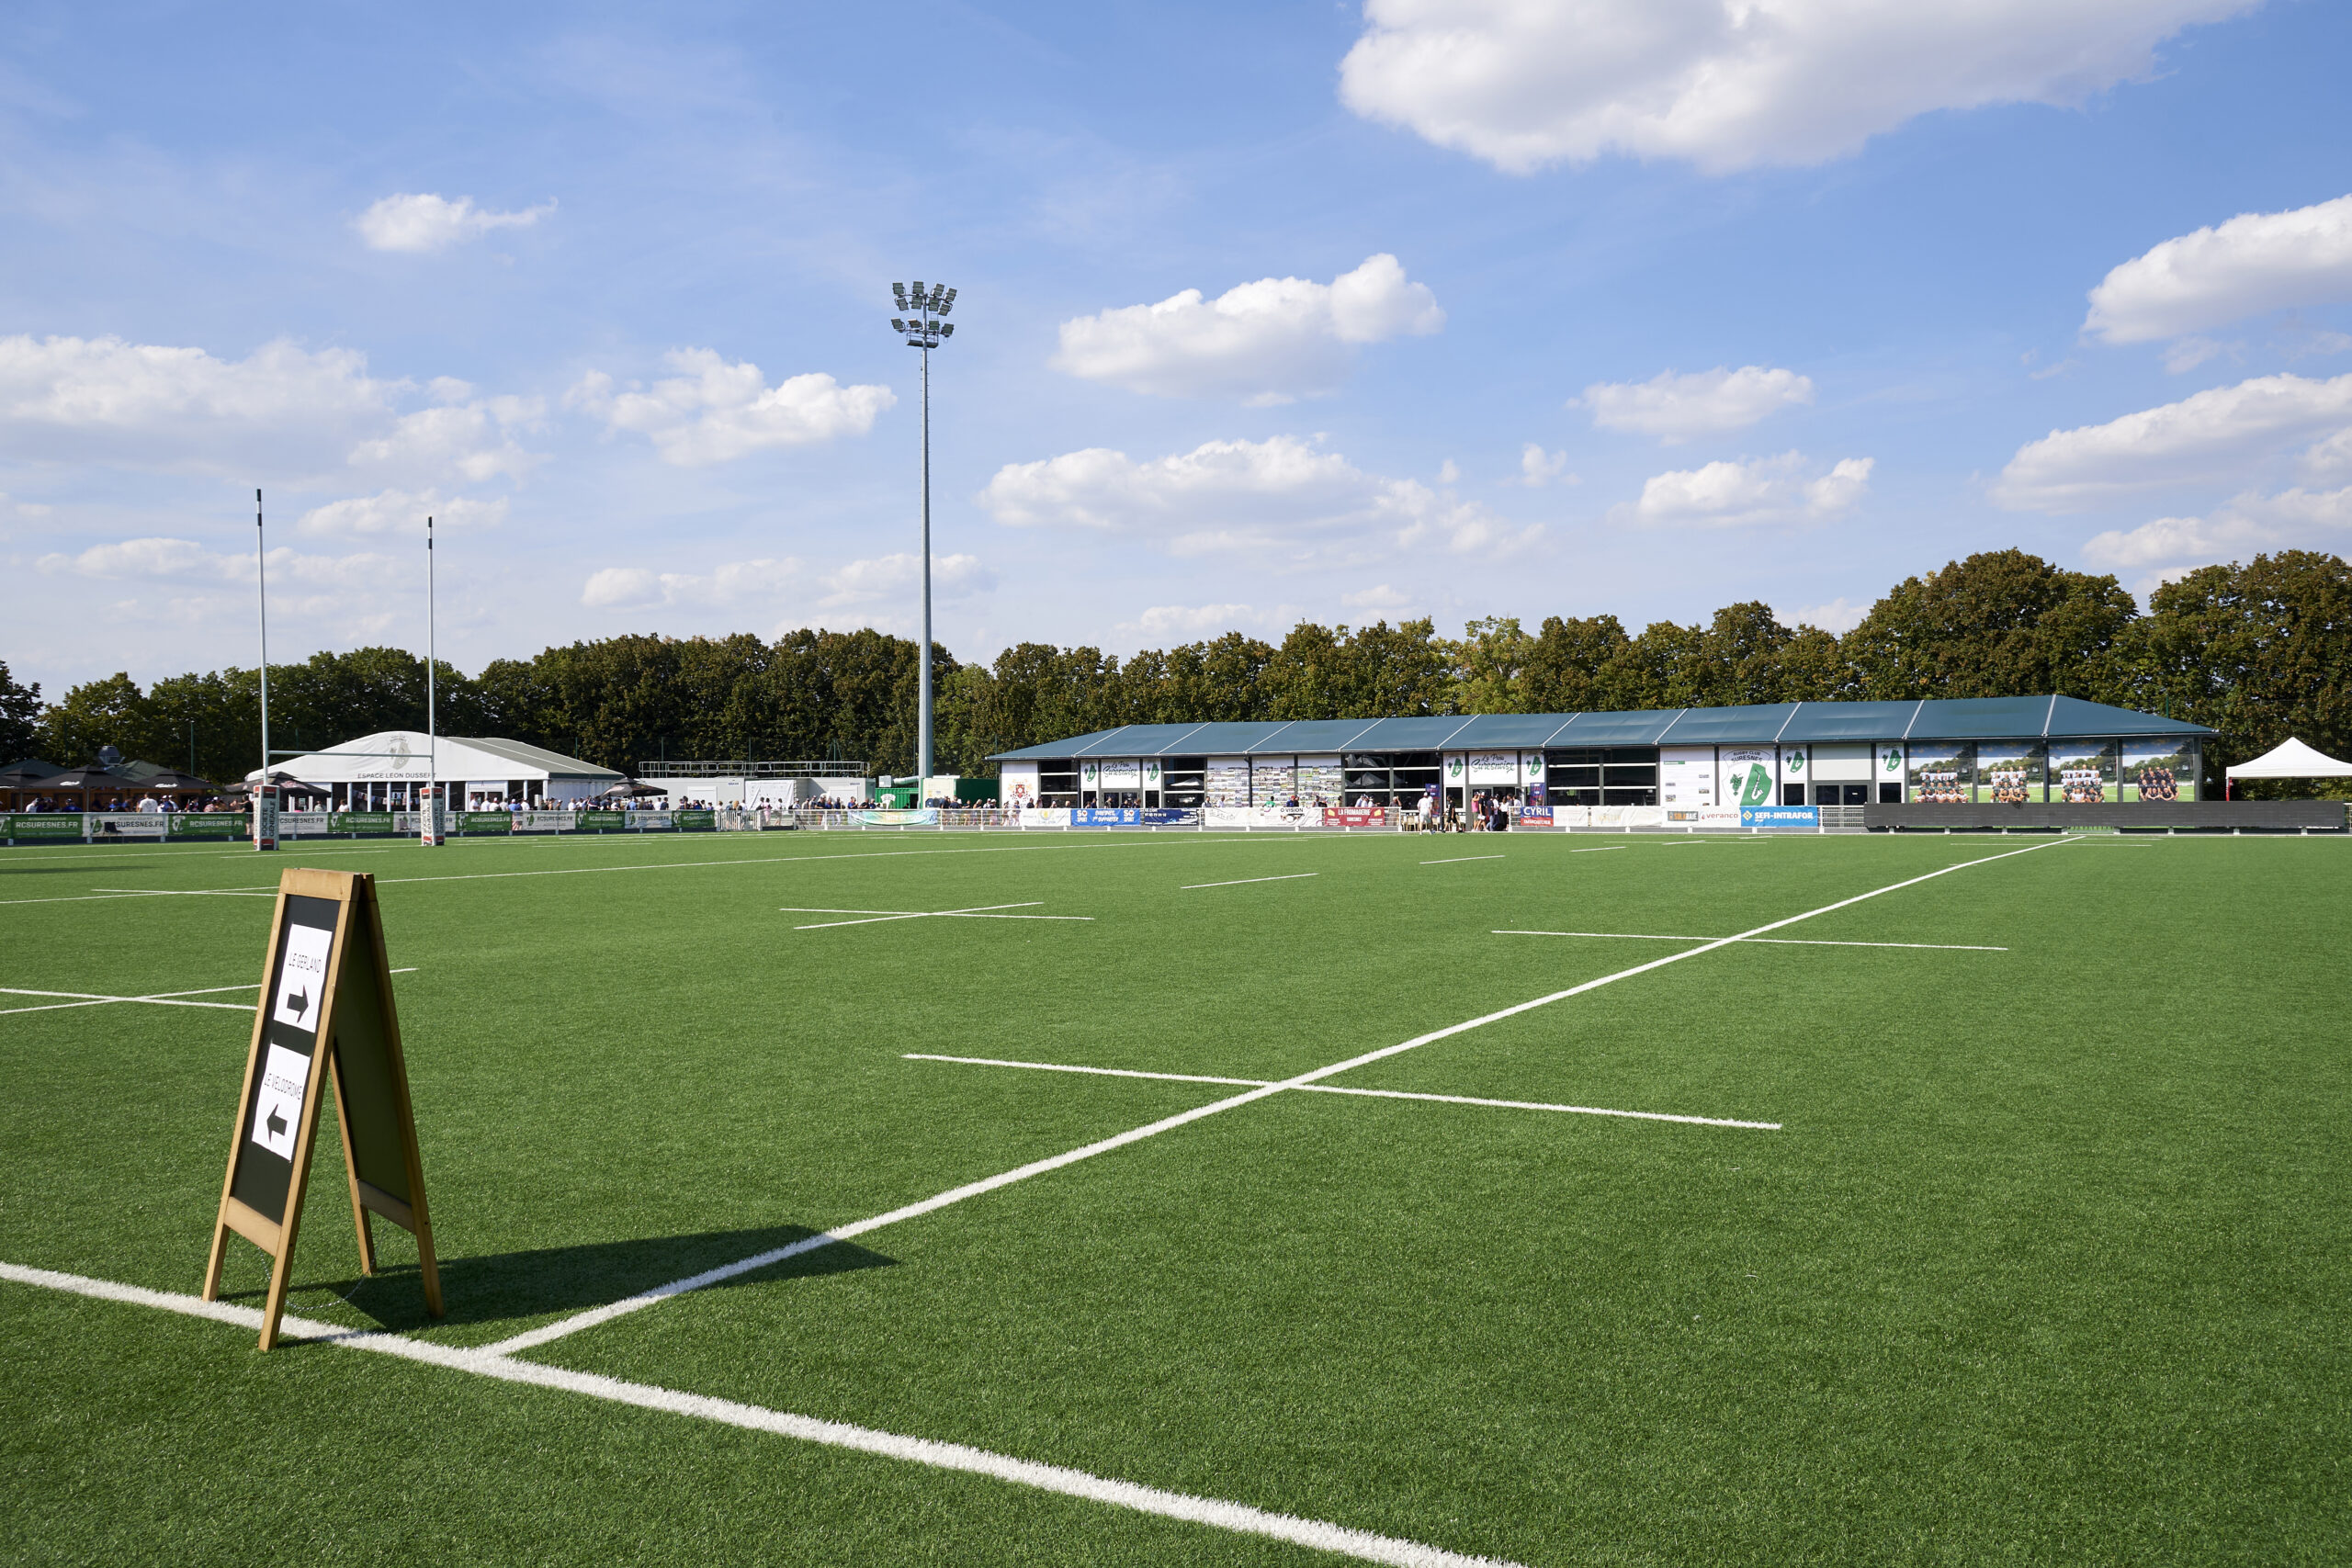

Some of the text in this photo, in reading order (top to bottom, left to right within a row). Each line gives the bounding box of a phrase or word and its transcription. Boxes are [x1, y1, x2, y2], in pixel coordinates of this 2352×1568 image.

[1731, 754, 1762, 762] SURESNES
[1523, 807, 1551, 816] CYRIL
[288, 952, 322, 973] LE GERLAND
[265, 1073, 302, 1100] LE VELODROME
